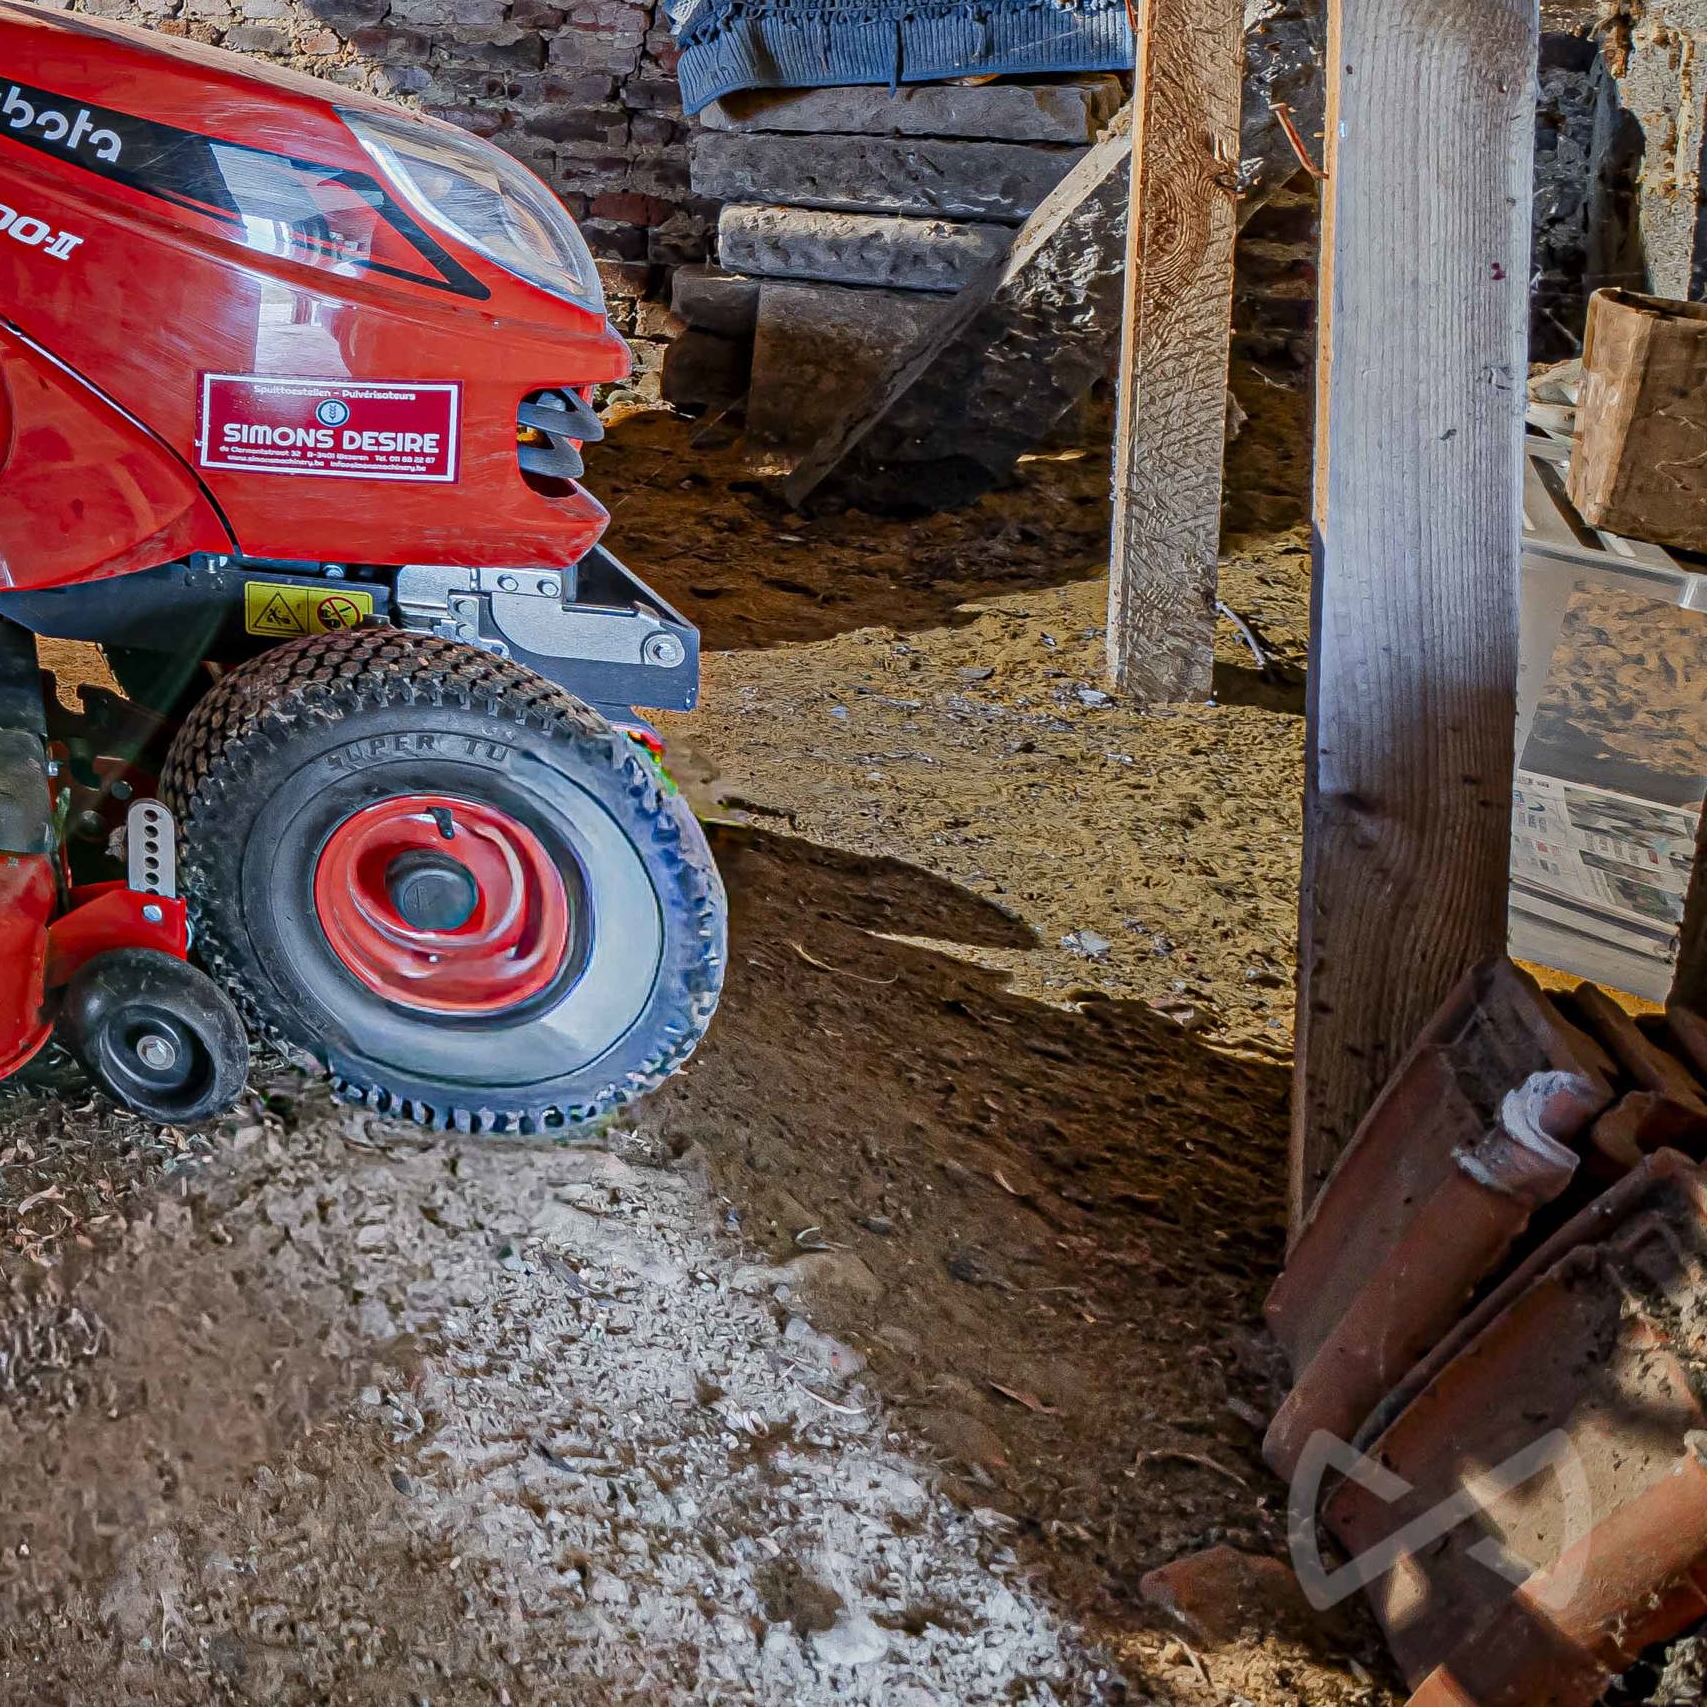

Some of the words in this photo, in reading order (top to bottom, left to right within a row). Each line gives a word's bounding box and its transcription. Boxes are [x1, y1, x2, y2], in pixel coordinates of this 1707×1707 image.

[253, 385, 331, 397] Spuittoestellen
[342, 389, 416, 401] Pulvérisateurs
[223, 423, 335, 448] SIMONS
[342, 430, 440, 454] DESIRE
